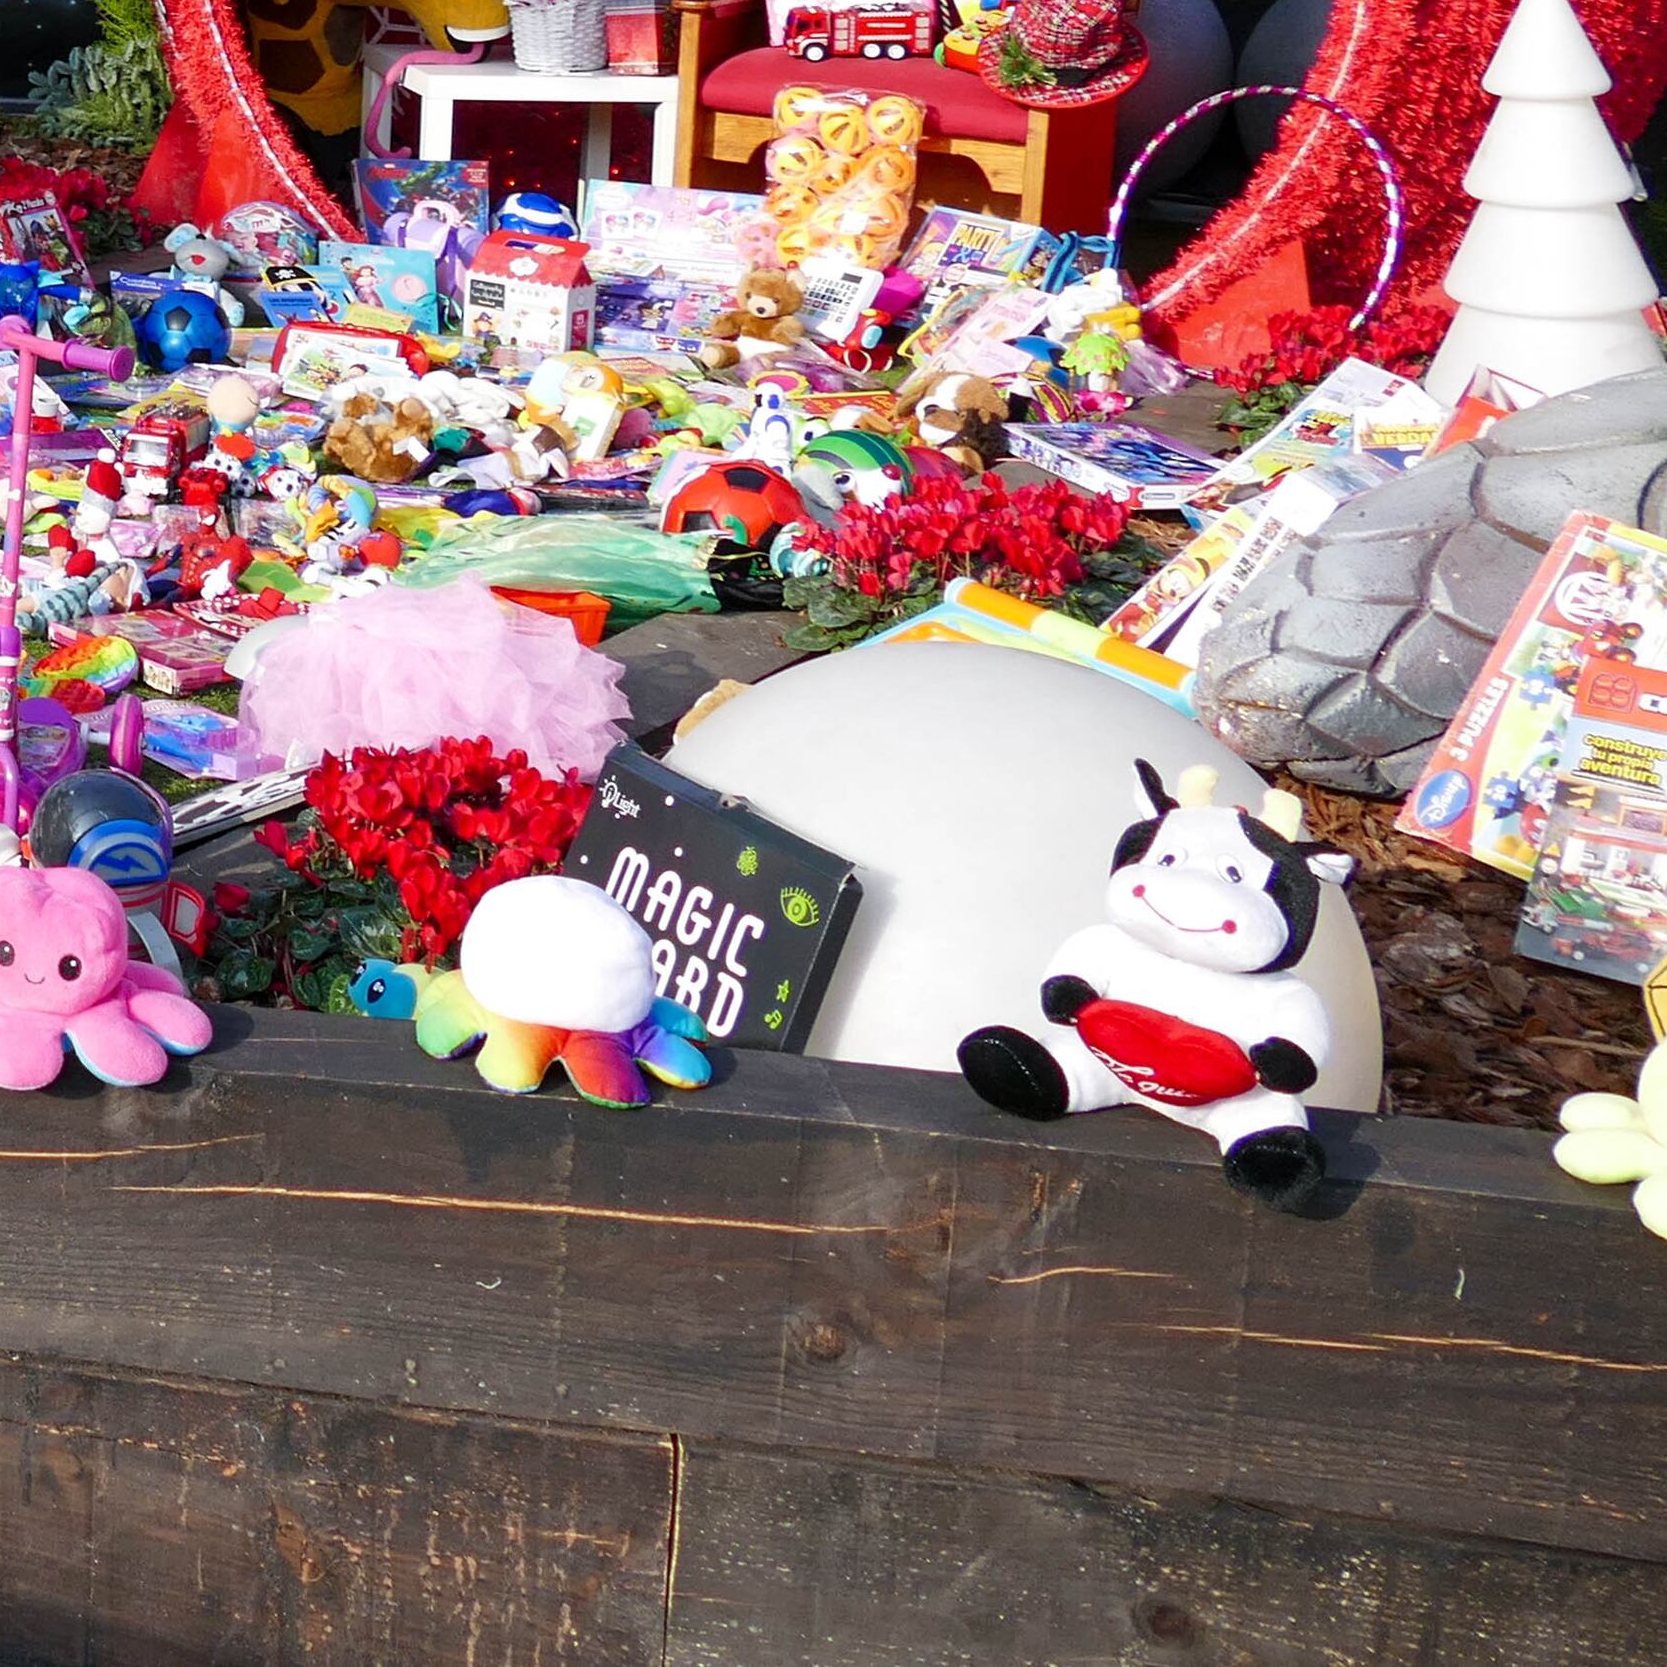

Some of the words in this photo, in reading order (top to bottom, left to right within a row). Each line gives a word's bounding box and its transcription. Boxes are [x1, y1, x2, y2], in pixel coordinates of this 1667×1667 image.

[1450, 744, 1470, 762] 3
[1460, 675, 1512, 744] PUZZLES
[1420, 775, 1464, 822] Disney
[1579, 757, 1662, 786] aventura
[606, 846, 766, 978] MAGIC
[651, 937, 745, 1038] ARD
